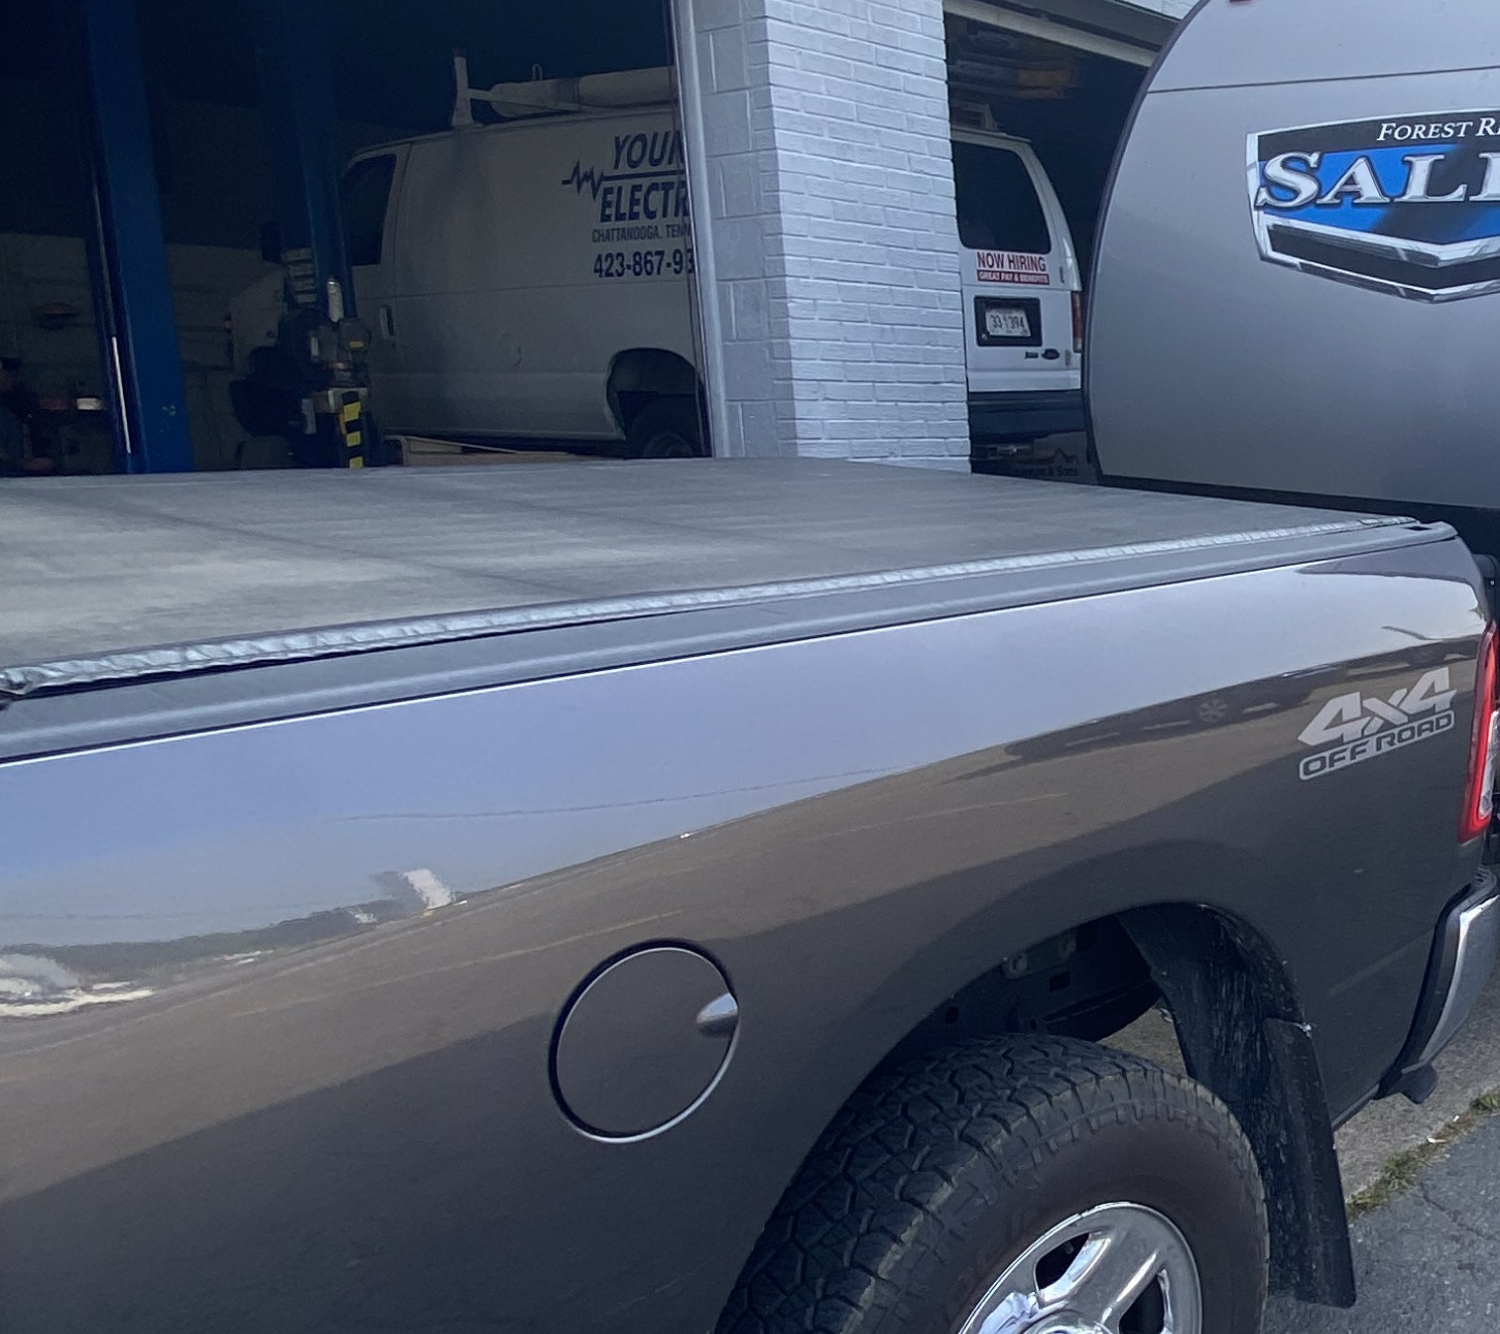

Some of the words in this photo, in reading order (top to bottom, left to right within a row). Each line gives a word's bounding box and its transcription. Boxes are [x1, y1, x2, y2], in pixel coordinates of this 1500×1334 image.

[1376, 121, 1473, 142] FOREST
[977, 252, 1004, 269] NOW
[1007, 253, 1046, 272] HIRING
[1302, 739, 1370, 776] OFF
[1375, 711, 1451, 752] ROAD
